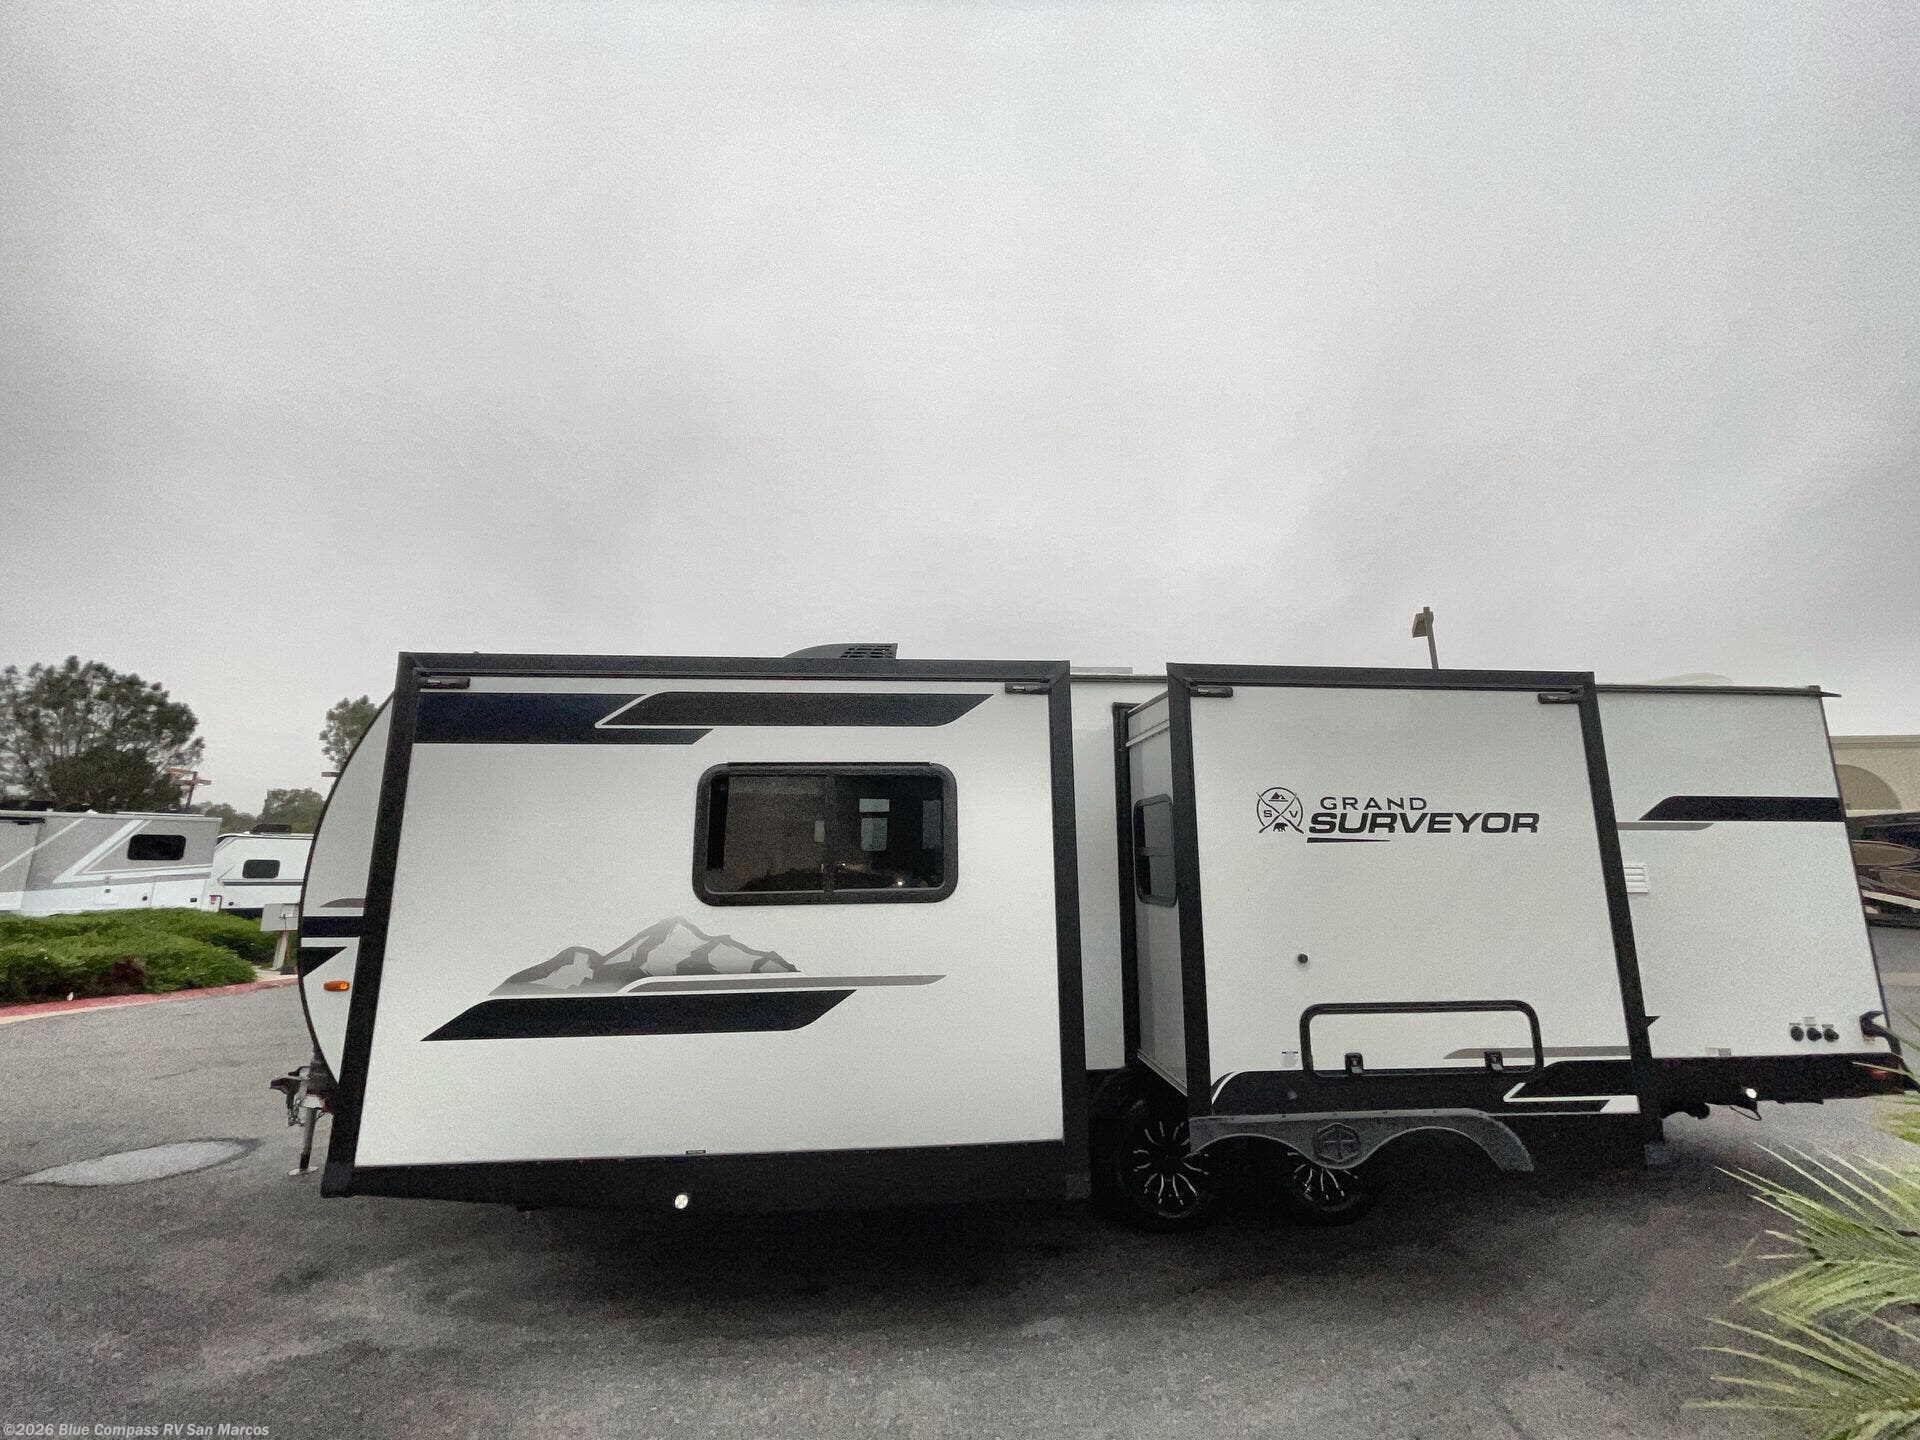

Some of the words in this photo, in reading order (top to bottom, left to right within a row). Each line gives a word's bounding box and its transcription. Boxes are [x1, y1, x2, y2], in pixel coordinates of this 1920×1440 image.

[1320, 796, 1427, 811] GRAND
[1263, 809, 1273, 818] S
[1289, 810, 1299, 818] V
[1308, 812, 1540, 834] SURVEYOR
